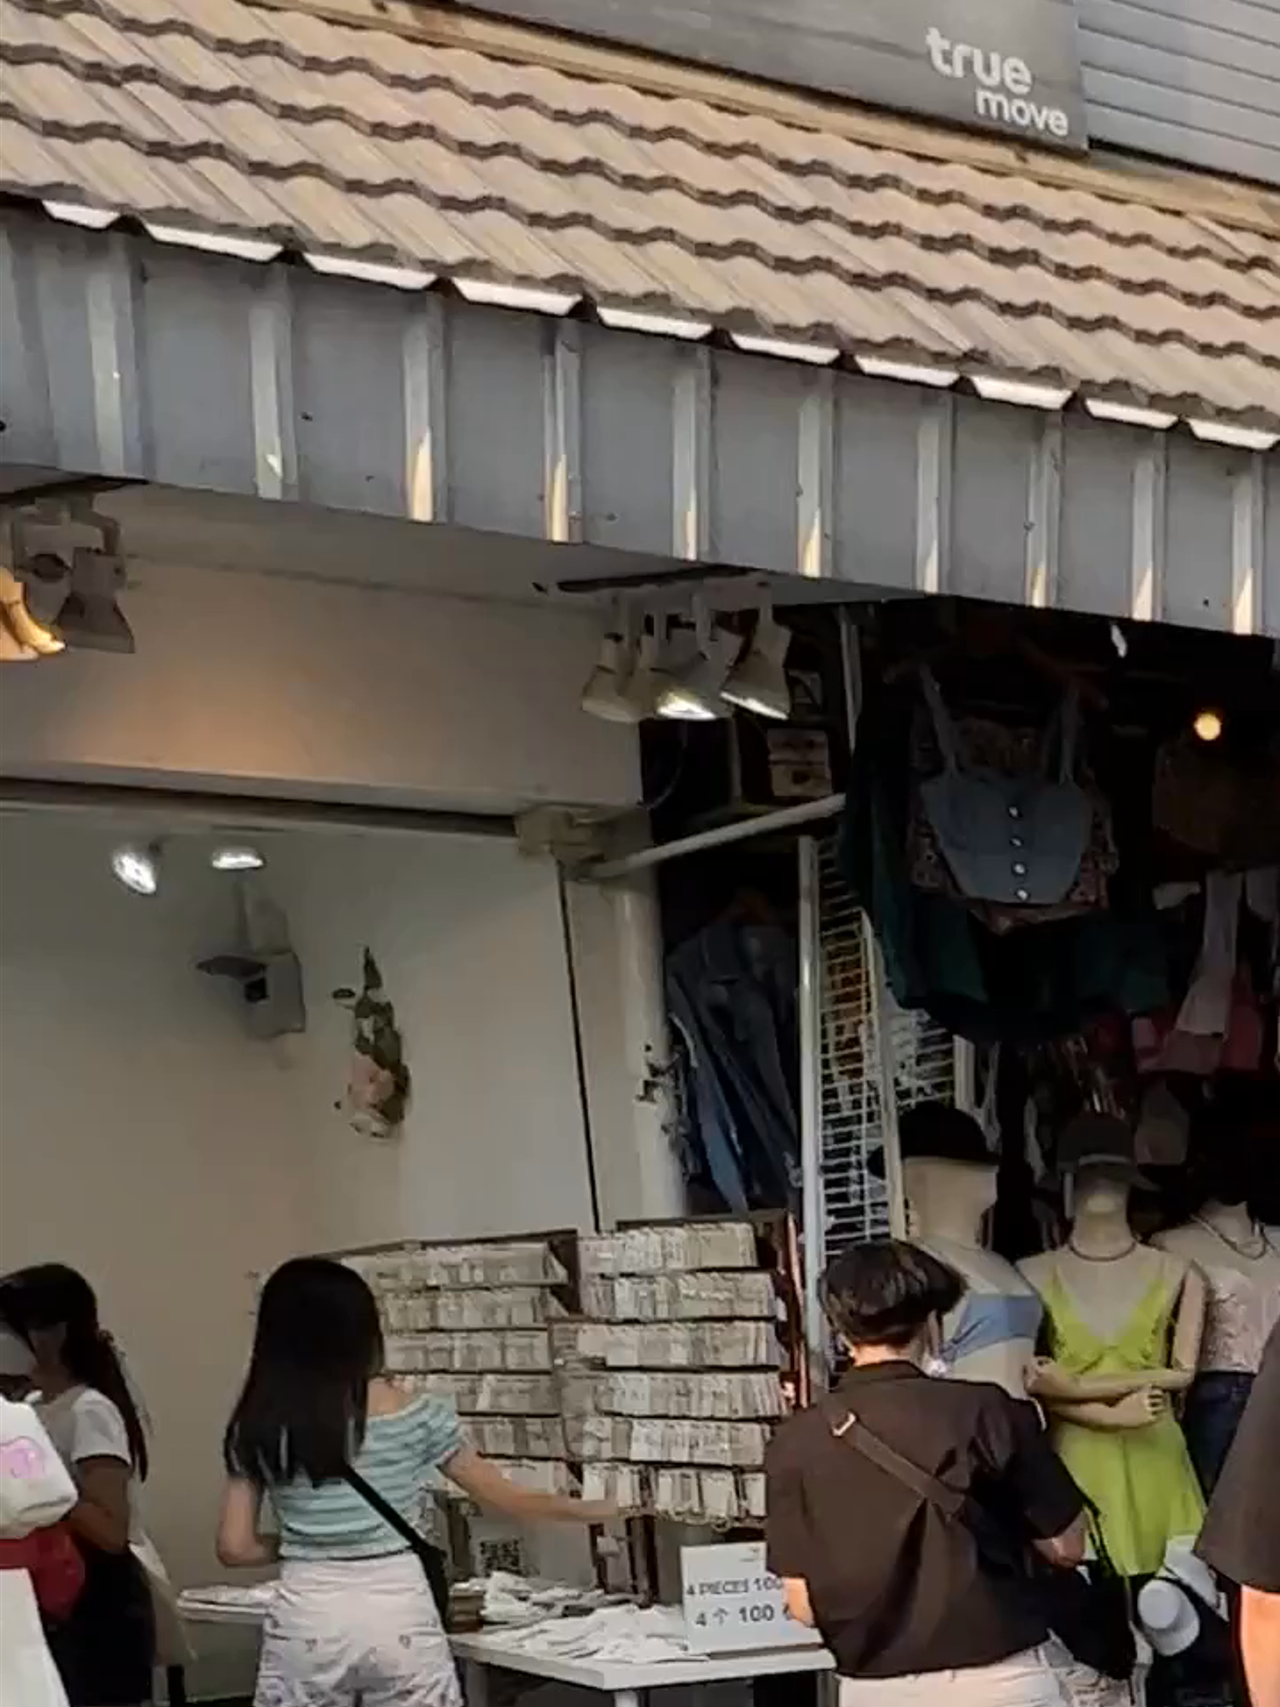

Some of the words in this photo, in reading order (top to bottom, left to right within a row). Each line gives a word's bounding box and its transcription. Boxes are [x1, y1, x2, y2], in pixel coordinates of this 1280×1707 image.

[925, 26, 1032, 95] true
[975, 88, 1069, 137] move
[739, 1604, 775, 1622] 100
